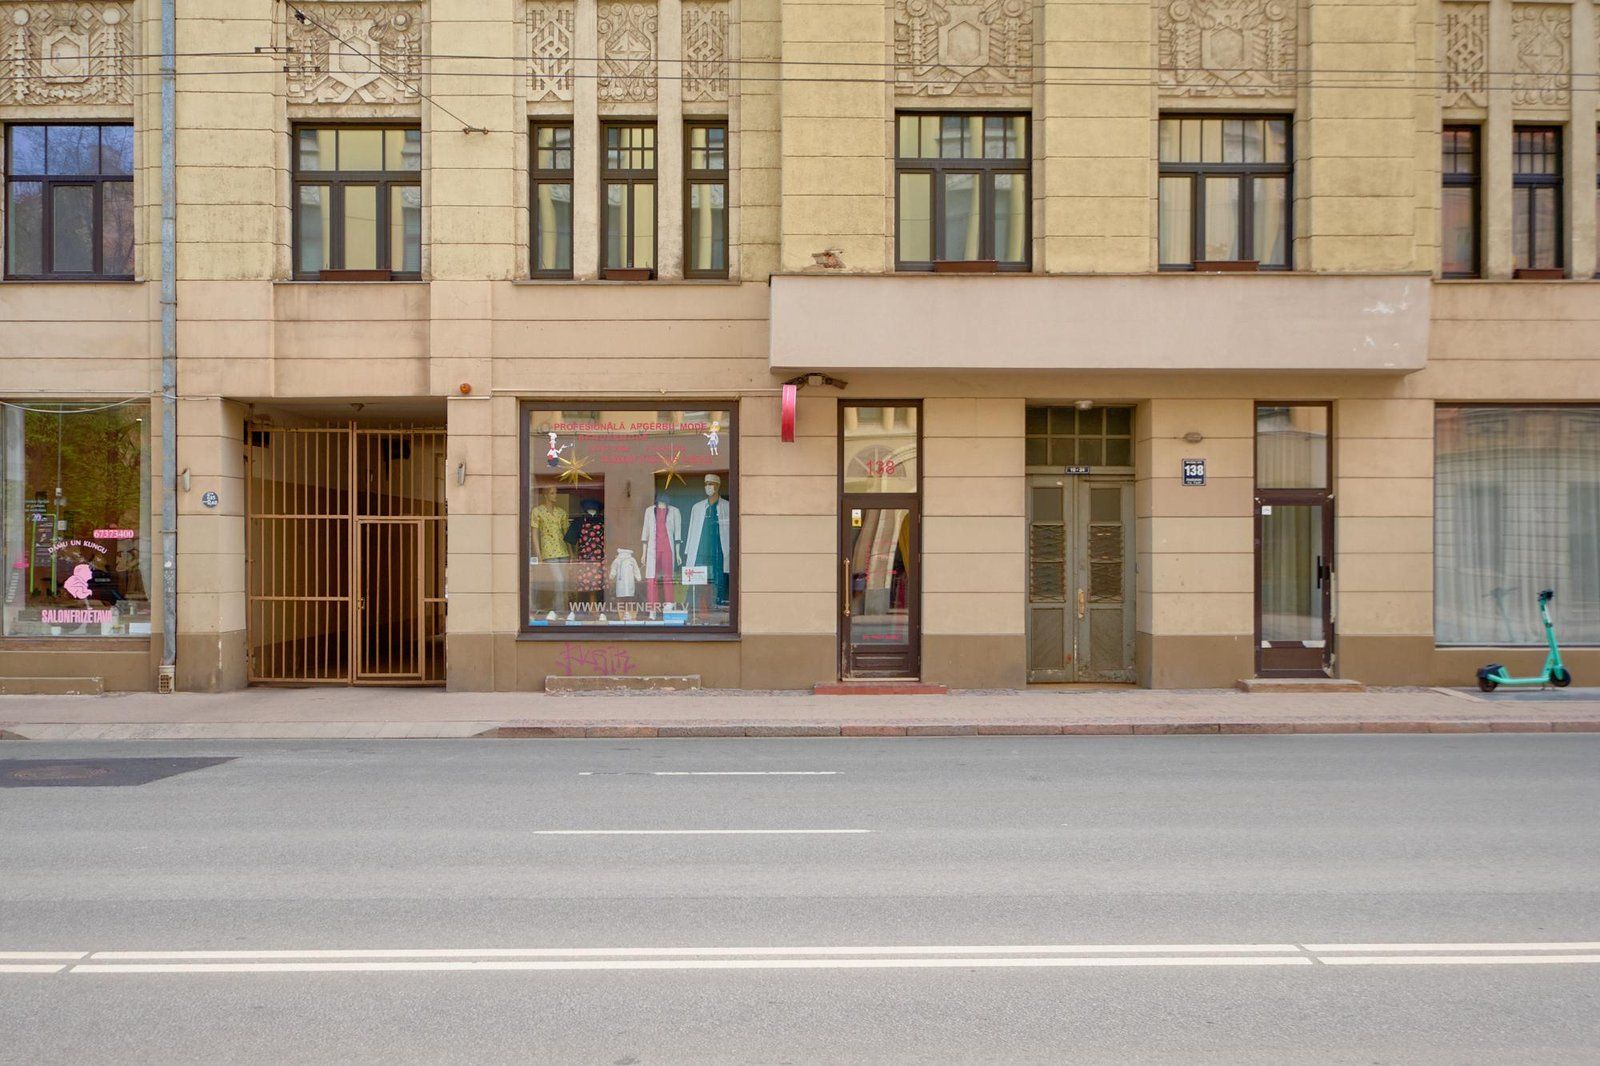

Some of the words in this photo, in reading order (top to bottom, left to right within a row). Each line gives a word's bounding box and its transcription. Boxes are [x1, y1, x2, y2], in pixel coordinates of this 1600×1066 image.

[680, 423, 707, 431] MODE
[866, 459, 895, 475] 138
[1184, 465, 1204, 476] 138
